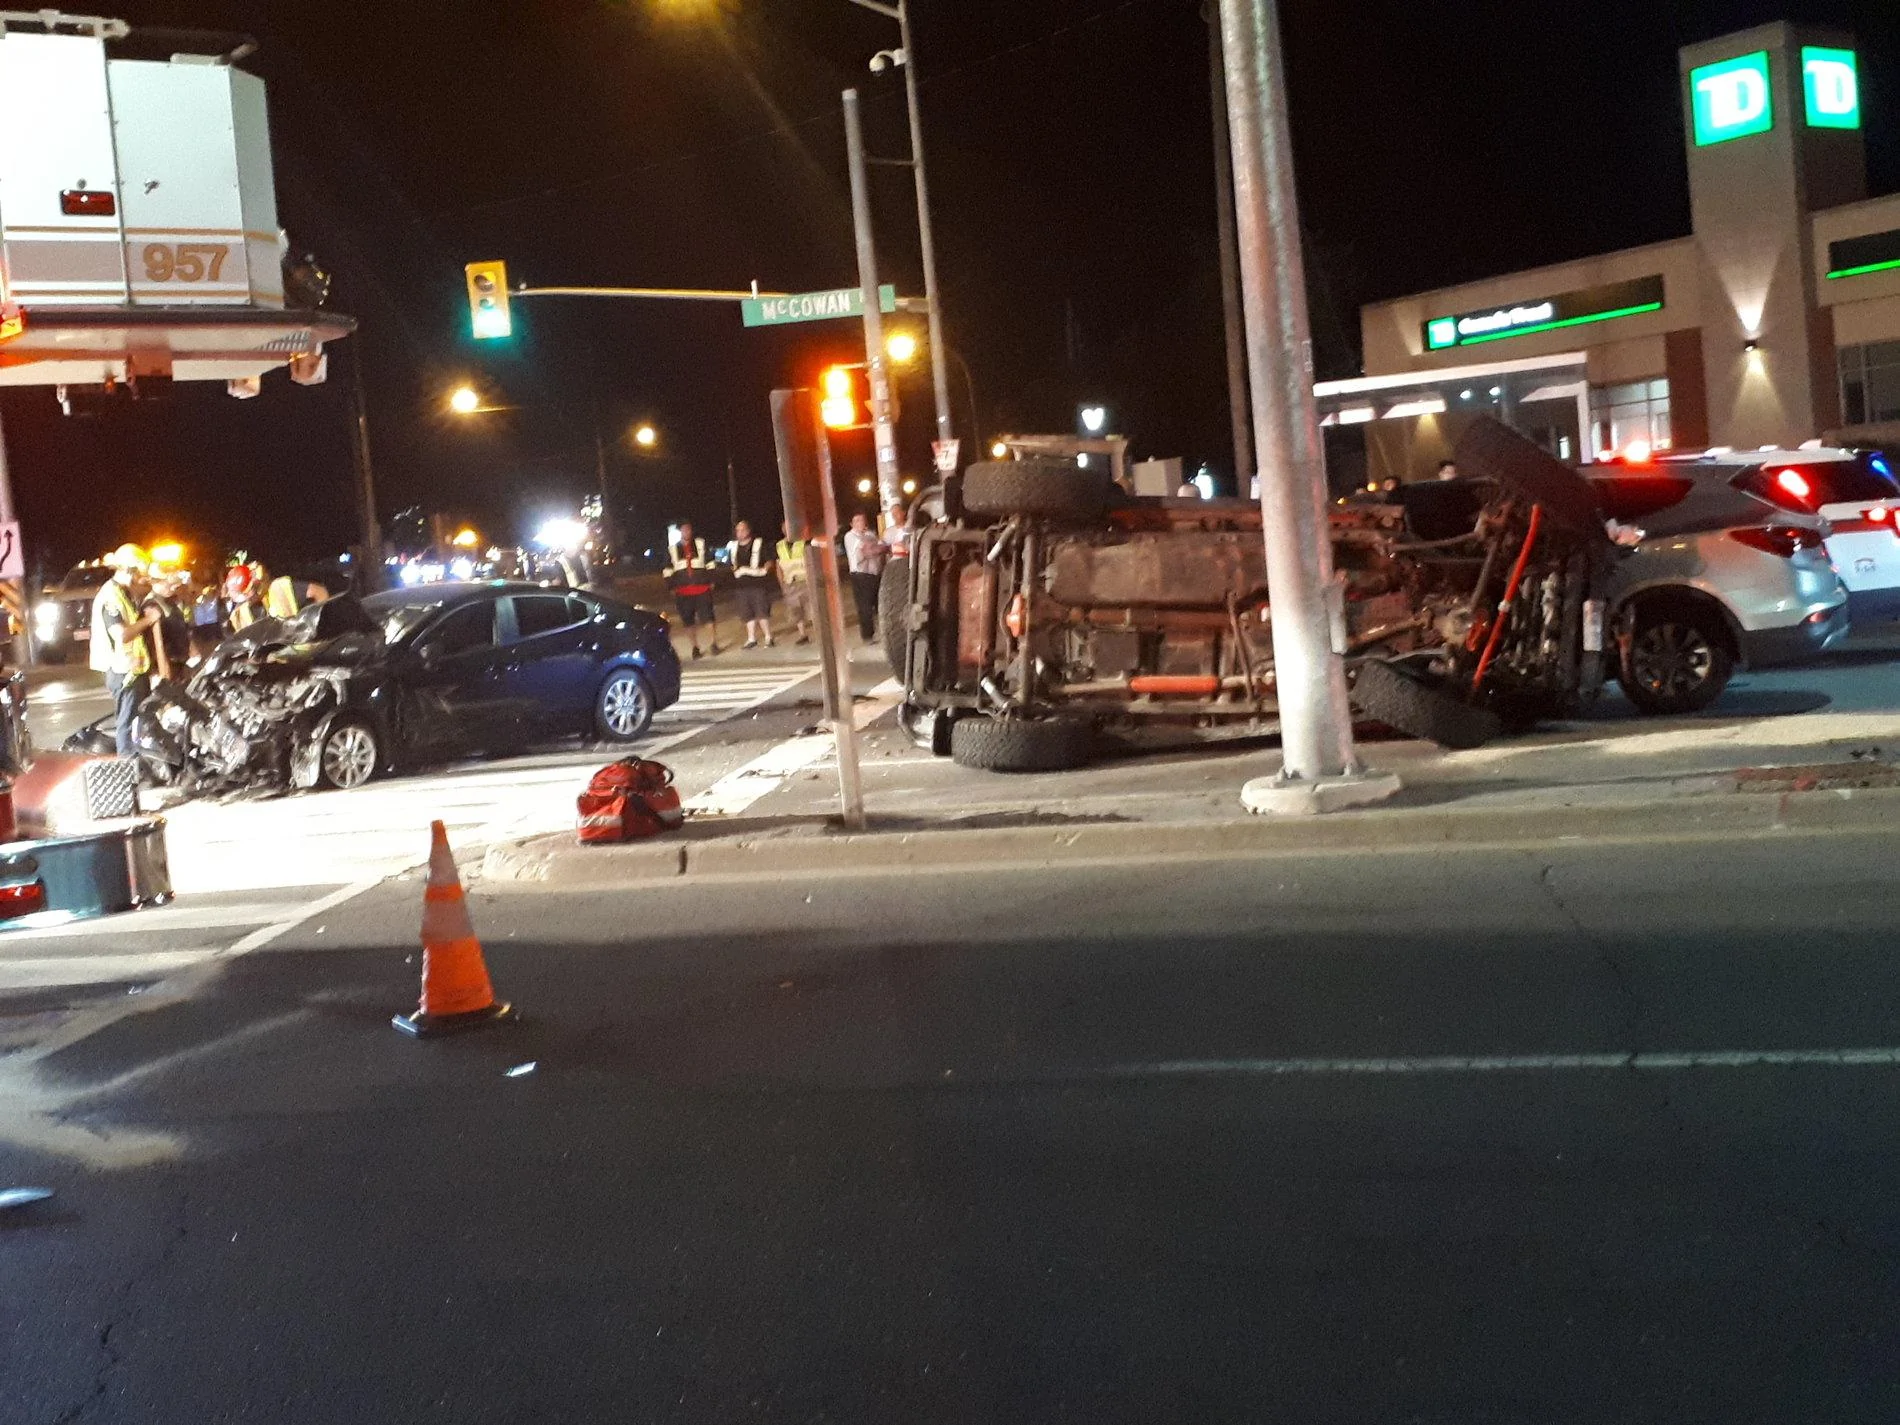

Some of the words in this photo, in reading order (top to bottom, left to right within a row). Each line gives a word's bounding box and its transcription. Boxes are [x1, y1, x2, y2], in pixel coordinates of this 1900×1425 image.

[1697, 67, 1764, 129] TD
[1805, 60, 1857, 114] TD
[144, 243, 228, 282] 957
